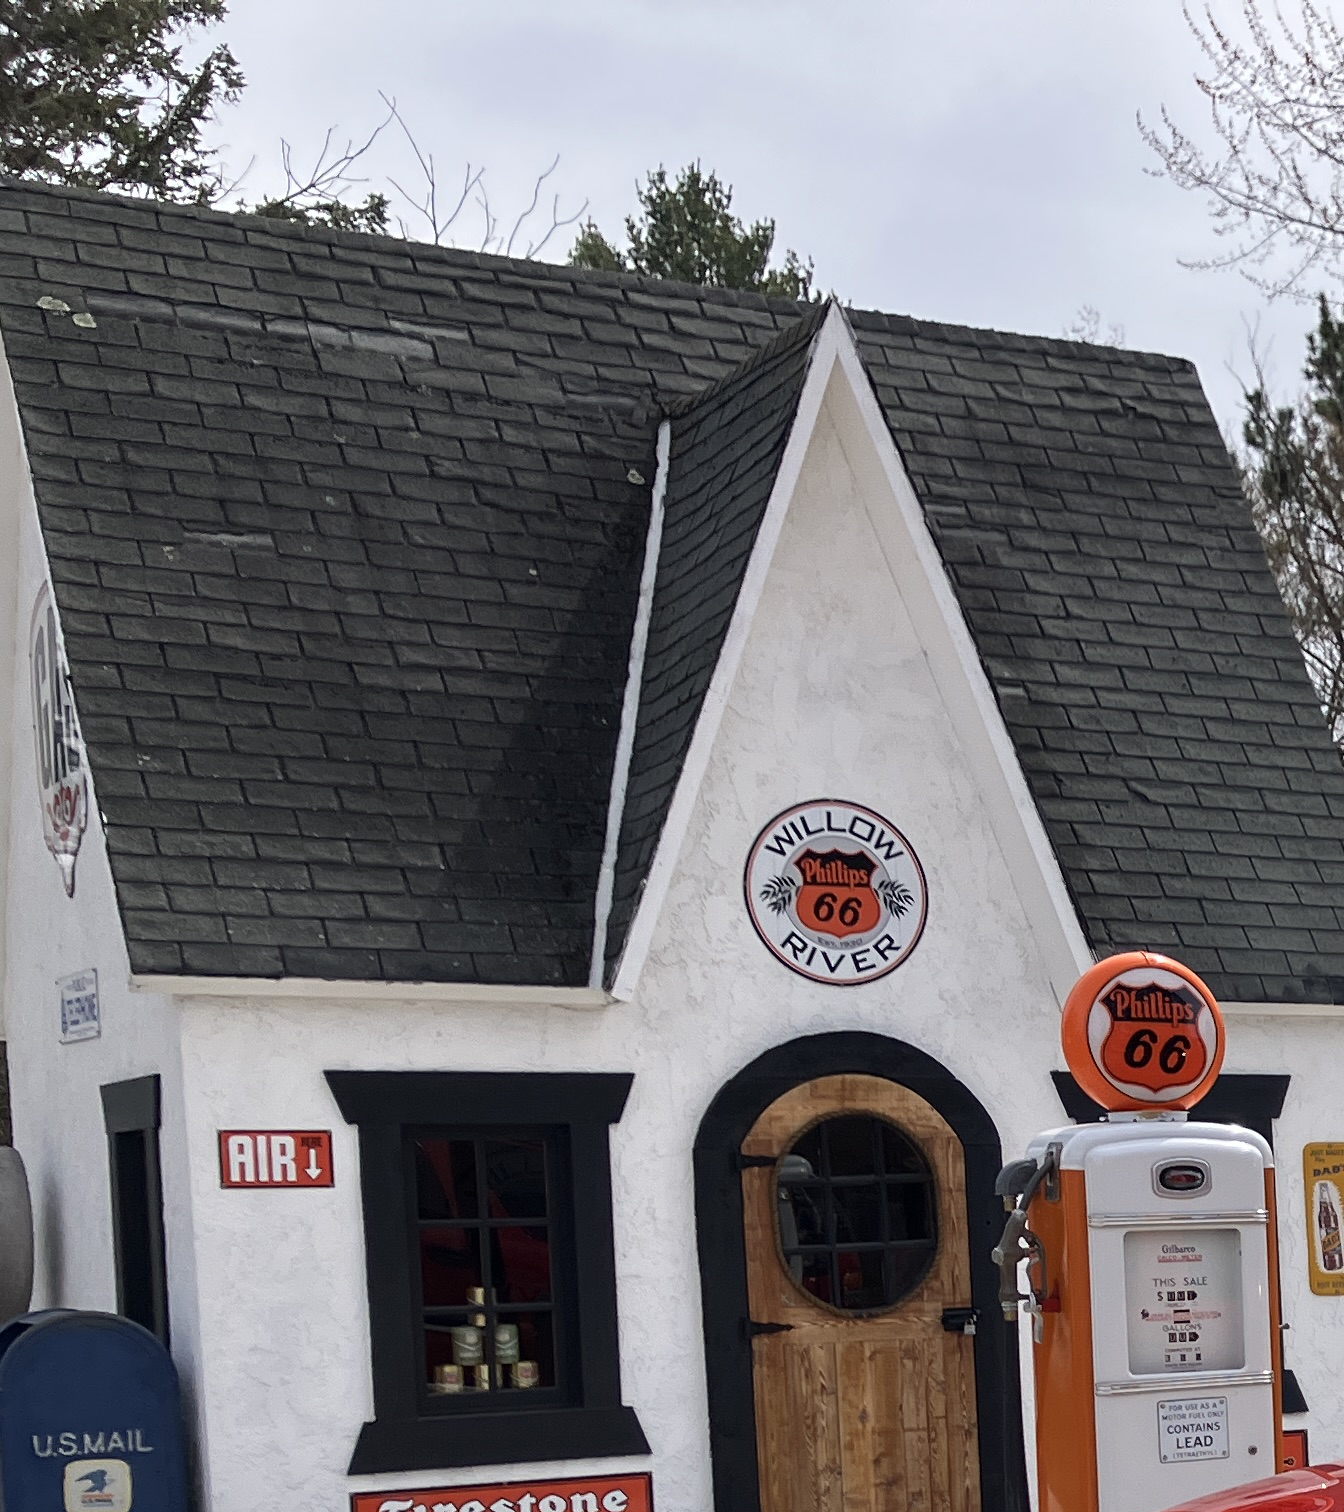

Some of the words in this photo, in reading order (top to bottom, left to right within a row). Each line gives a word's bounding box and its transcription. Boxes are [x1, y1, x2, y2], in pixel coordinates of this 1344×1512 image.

[764, 810, 904, 860] WILLOW
[801, 857, 868, 890] Phillips
[814, 892, 862, 927] 66
[780, 931, 901, 973] RIVER
[1110, 988, 1195, 1028] Phillips
[1124, 1029, 1191, 1074] 66
[228, 1135, 297, 1182] AIR
[1161, 1244, 1196, 1253] Gilbarco
[1152, 1278, 1176, 1287] THIS
[1183, 1276, 1208, 1286] SALE
[1162, 1324, 1202, 1332] GALLONS
[1162, 1413, 1187, 1421] MOTOR
[1167, 1421, 1221, 1434] CONTAINS
[1176, 1435, 1213, 1449] LEAD
